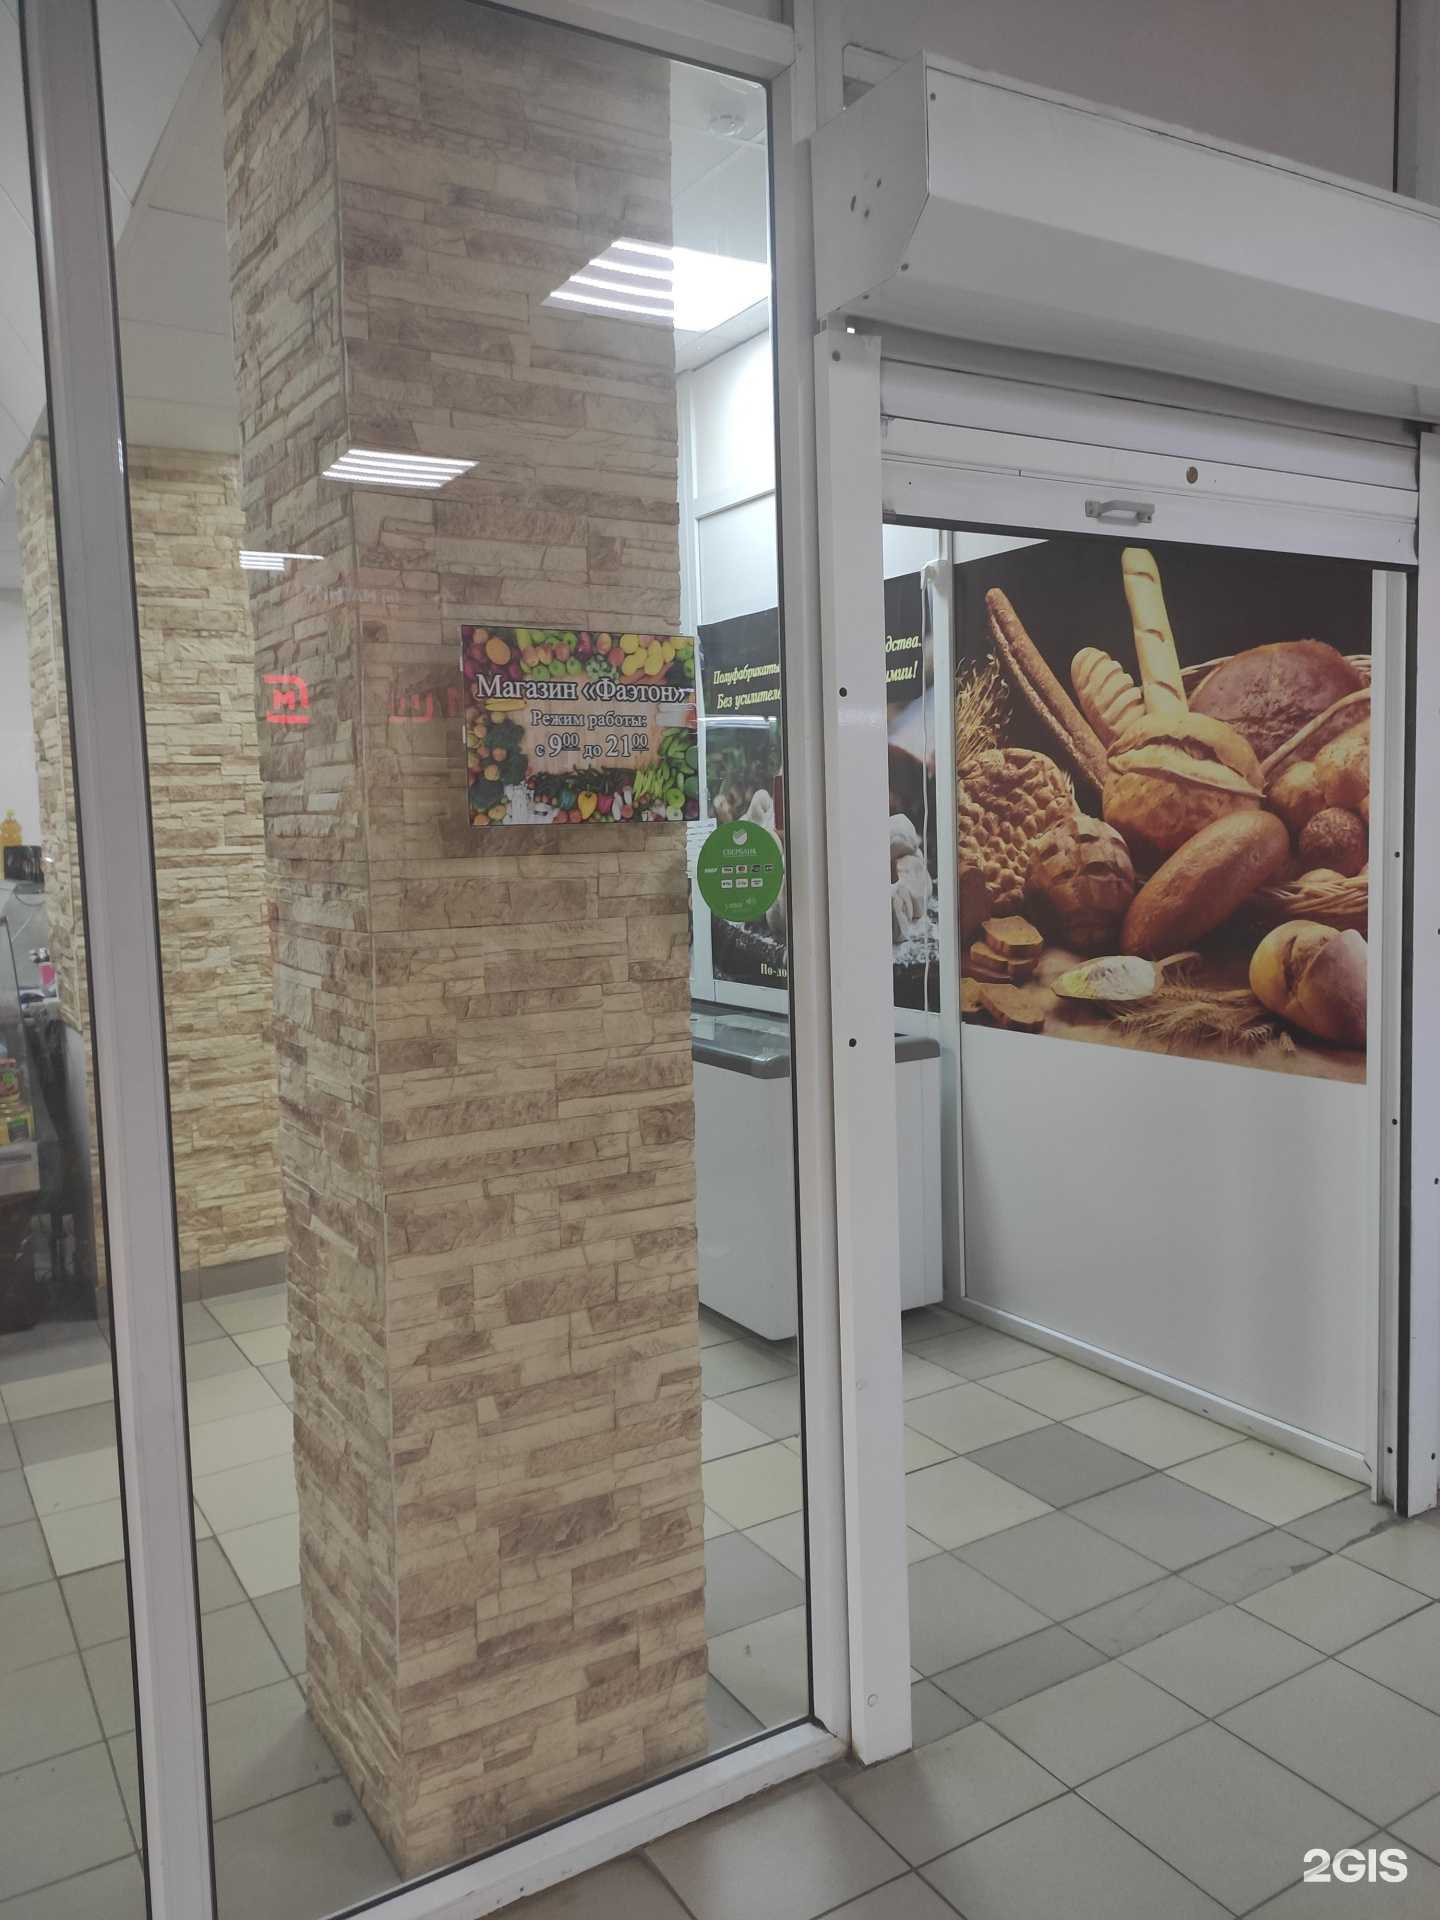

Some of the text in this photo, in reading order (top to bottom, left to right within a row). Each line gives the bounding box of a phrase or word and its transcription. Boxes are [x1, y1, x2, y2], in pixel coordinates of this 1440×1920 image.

[476, 673, 686, 702] Магазин «Фаэтон»
[717, 693, 733, 709] Без
[531, 710, 648, 730] Режим работы:
[535, 744, 545, 757] с
[584, 745, 602, 759] до
